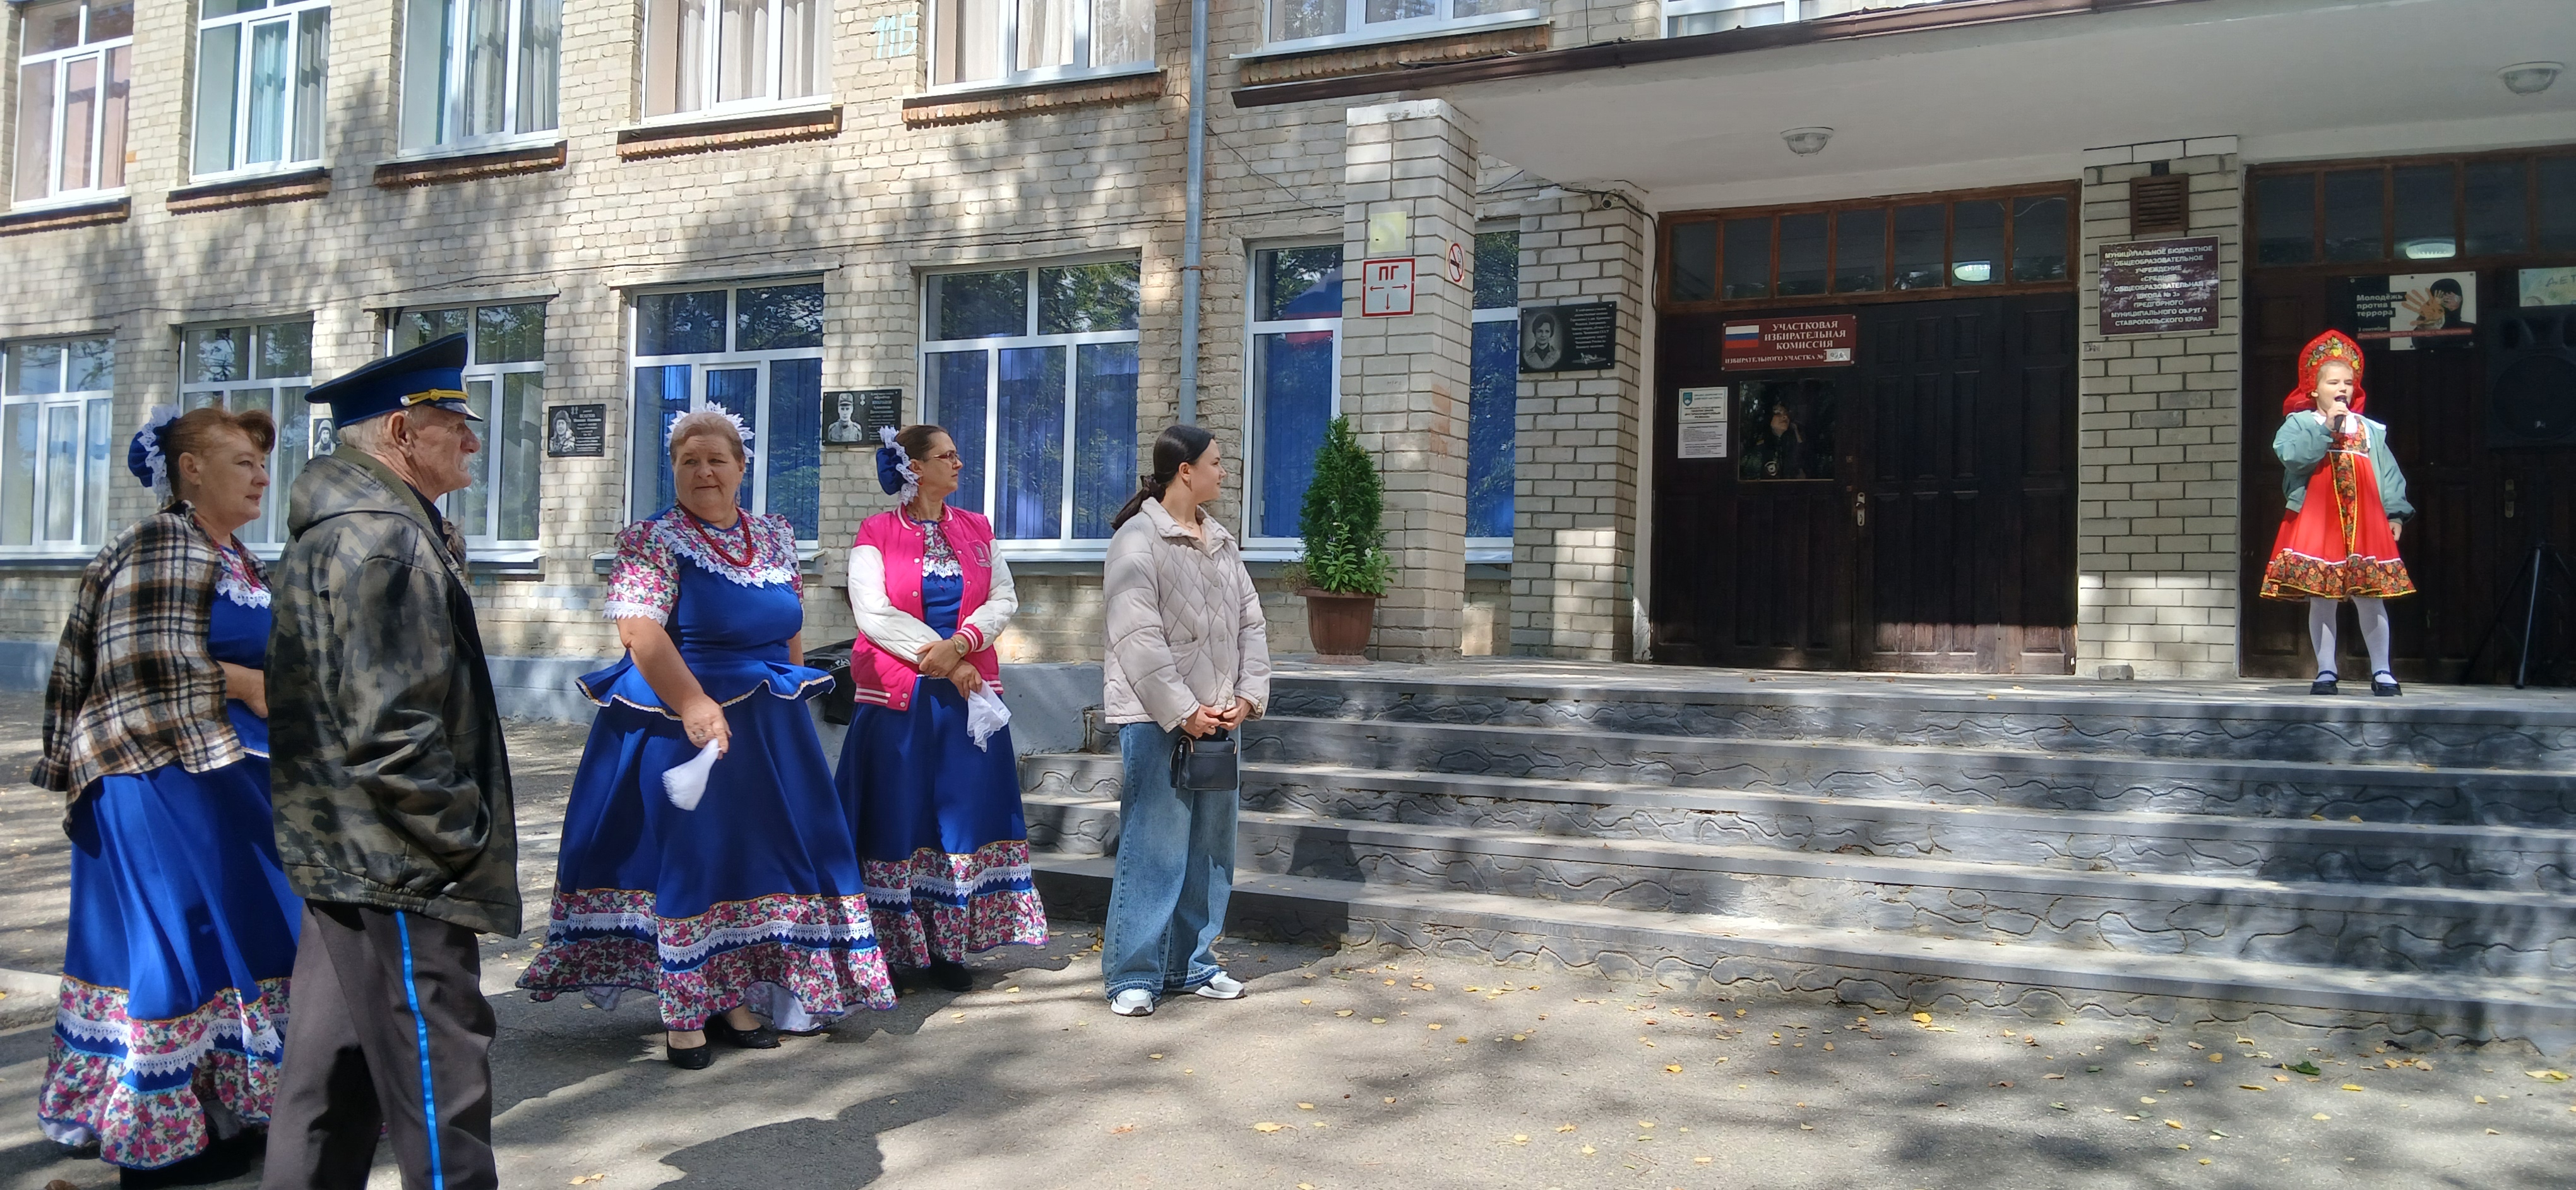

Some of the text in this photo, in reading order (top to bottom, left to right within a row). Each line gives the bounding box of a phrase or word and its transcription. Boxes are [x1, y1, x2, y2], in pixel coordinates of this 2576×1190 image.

[2105, 245, 2213, 259] МУНИЦИПАЛЬНОЕ БЮДЖЕТНОЕ
[2114, 255, 2203, 267] ОБЩЕОБРАЗОВАТЕЛЬНОЕ
[1378, 265, 1399, 281] ПГ
[2135, 265, 2182, 274] УЧРЕЖДЕНИЕ
[2113, 281, 2204, 292] ОБЩЕОБРАЗОВАТЕЛЬНАЯ
[2133, 299, 2185, 308] ПРЕДГОРНОГО
[2356, 294, 2403, 302] Молодёжь
[2111, 308, 2177, 318] МУНИЦИПАЛЬНОГО
[1772, 320, 1839, 332] УЧАСТКОВАЯ
[2114, 316, 2184, 327] СТАВРОПОЛЬСКОГО
[1764, 330, 1846, 342] ИЗБИРАТЕЛЬНАЯ
[1776, 340, 1834, 350] КОМИССИЯ
